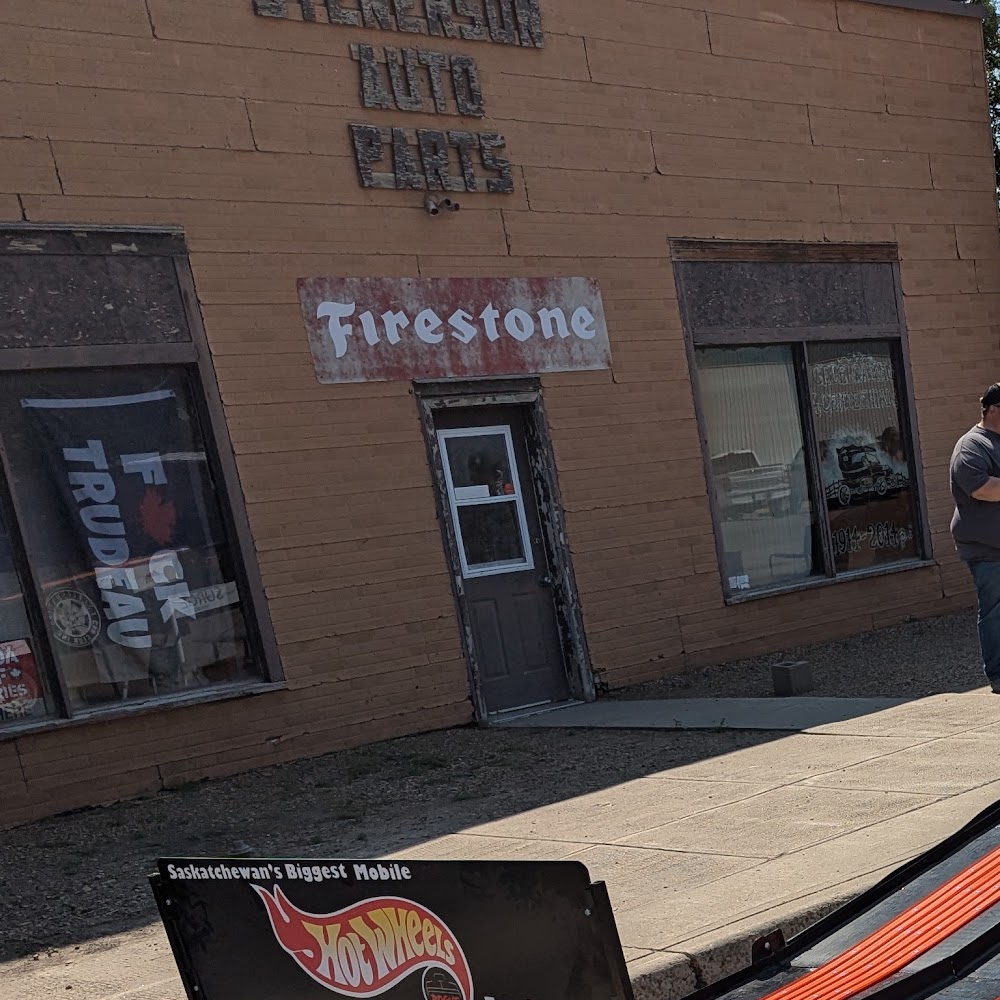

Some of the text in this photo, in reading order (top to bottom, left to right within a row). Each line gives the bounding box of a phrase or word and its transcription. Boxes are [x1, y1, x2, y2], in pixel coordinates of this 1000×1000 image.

[348, 43, 484, 118] AUTO
[348, 124, 514, 193] PARTS
[316, 301, 596, 358] Firestone
[62, 438, 153, 650] TRUDEAU
[167, 862, 412, 883] Saskatchewan's Biggest Mobile
